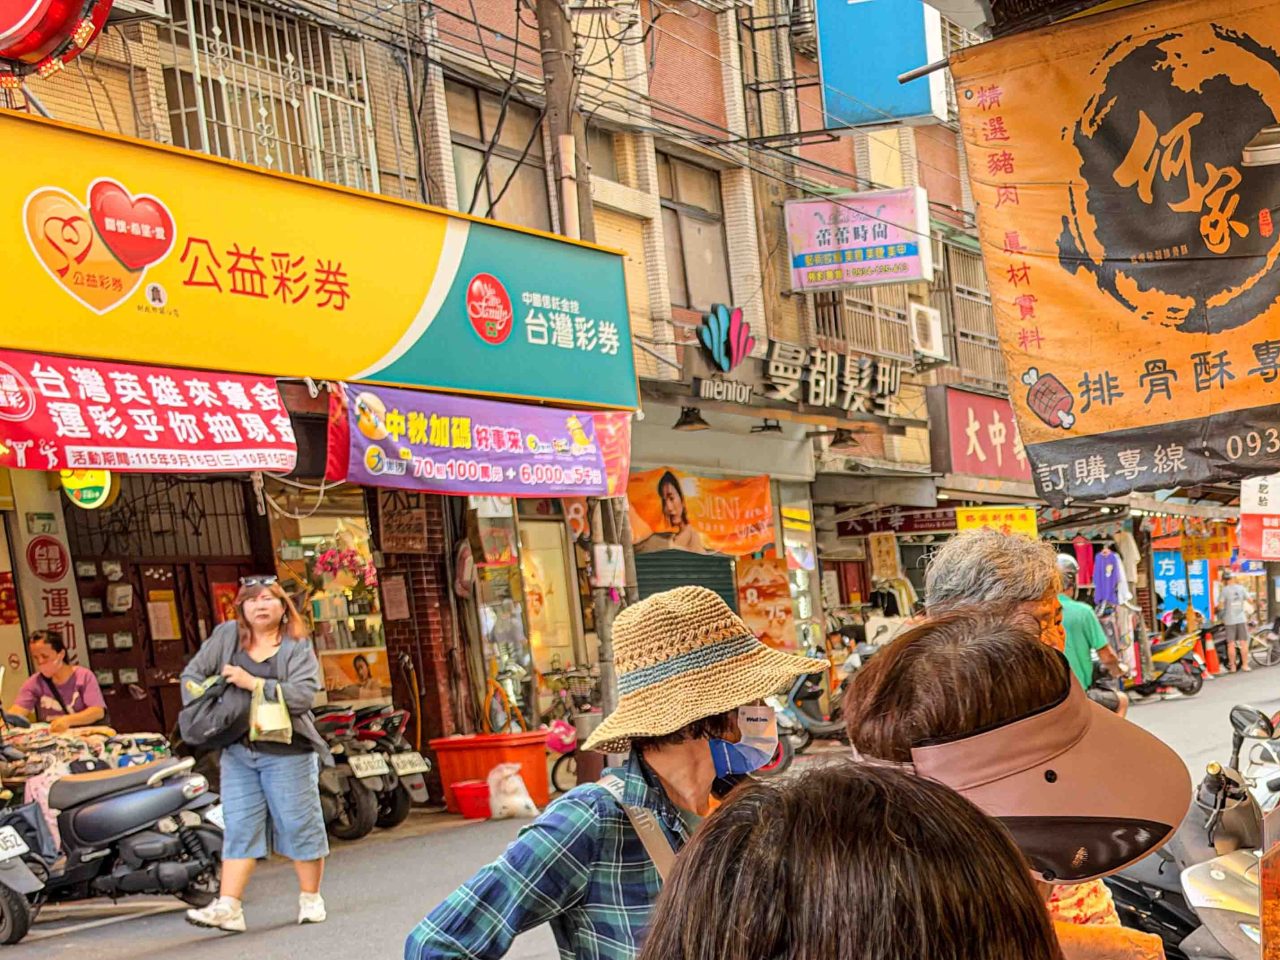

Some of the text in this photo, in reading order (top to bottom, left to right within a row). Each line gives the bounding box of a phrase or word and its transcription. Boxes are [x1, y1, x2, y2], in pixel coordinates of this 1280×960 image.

[976, 85, 1020, 209] 精選豬肉
[1112, 110, 1249, 255] 何家
[72, 270, 124, 292] 公益彩券
[179, 236, 351, 311] 公益彩券
[524, 308, 620, 355] 台灣彩券
[31, 361, 282, 411] 台灣英雄來奪金
[700, 379, 752, 404] mentor
[47, 401, 297, 444] 運彩乎你抽現金
[385, 409, 472, 449] 中秋加碼
